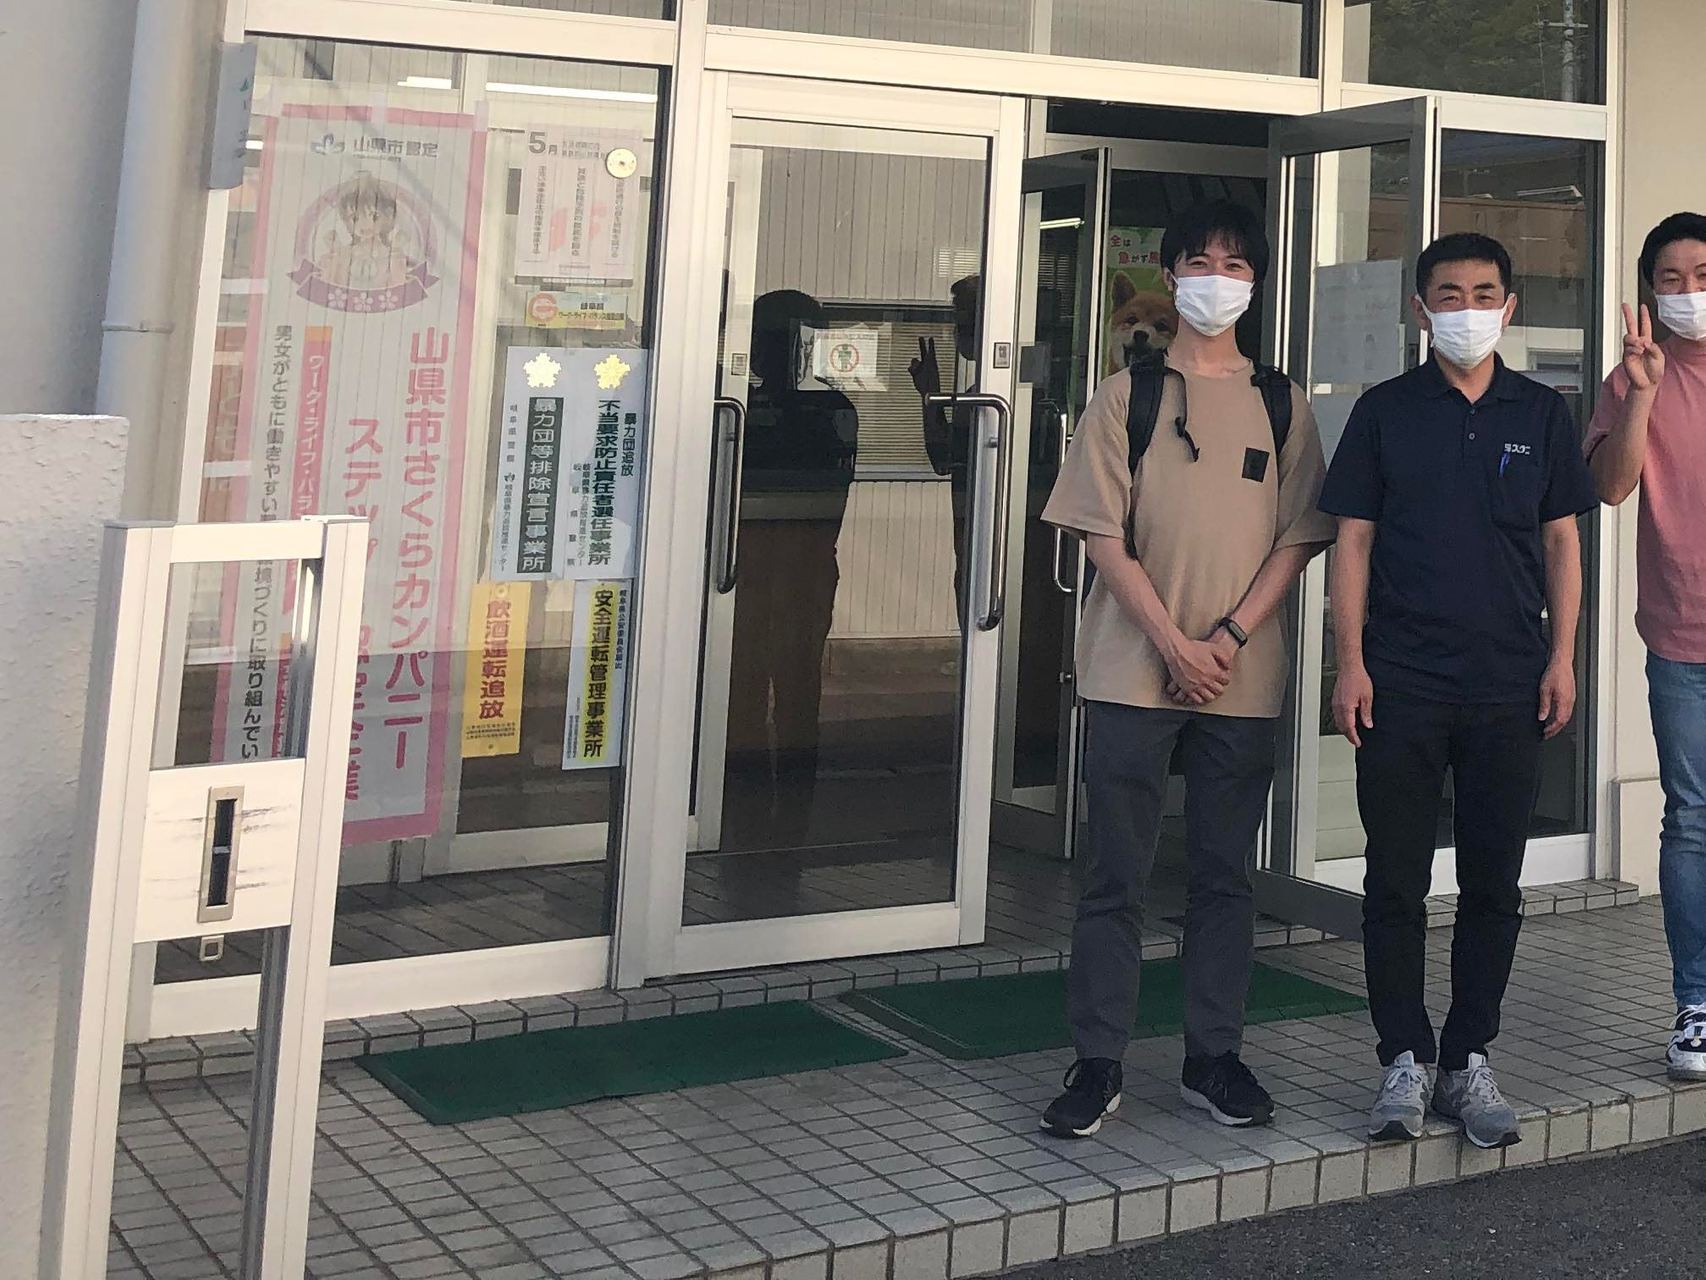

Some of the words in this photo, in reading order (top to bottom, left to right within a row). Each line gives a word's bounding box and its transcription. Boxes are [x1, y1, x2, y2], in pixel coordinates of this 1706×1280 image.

[296, 355, 325, 520] ワーク・ライフ・バラ
[521, 398, 558, 572] 暴力団等排除宣言事業所
[588, 400, 622, 566] 不当要求防止責任者選任事業所
[620, 412, 638, 477] 暴力団追放
[384, 327, 450, 770] 山県市さくらカンパニー
[479, 600, 512, 720] 飲酒運転追放
[583, 589, 614, 758] 安全運転管理事業所
